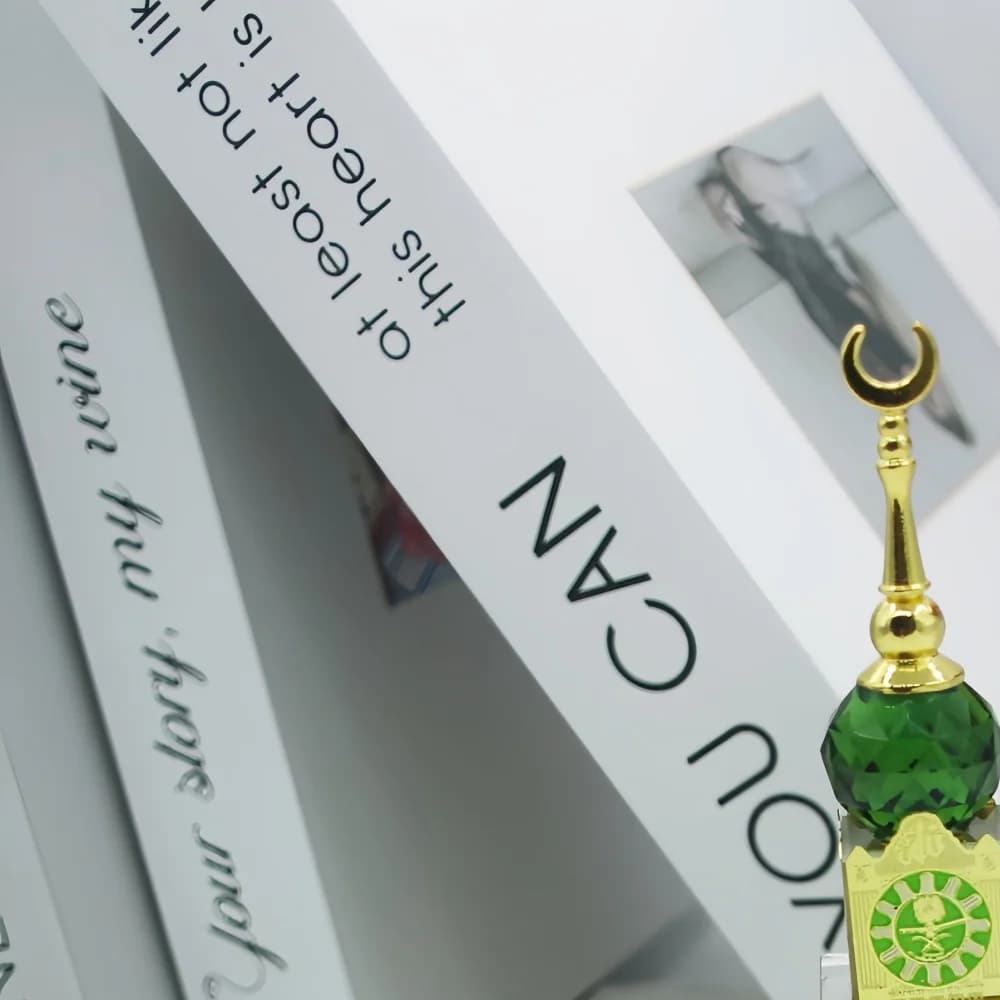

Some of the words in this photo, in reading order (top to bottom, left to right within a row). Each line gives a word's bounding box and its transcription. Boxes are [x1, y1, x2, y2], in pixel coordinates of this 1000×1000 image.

[233, 12, 273, 69] is
[177, 62, 257, 151] not
[267, 72, 392, 228] heart
[251, 164, 363, 302] least
[391, 229, 467, 328] this
[44, 291, 119, 456] wine
[355, 308, 412, 362] at
[97, 486, 165, 603] my
[497, 454, 698, 695] CAN
